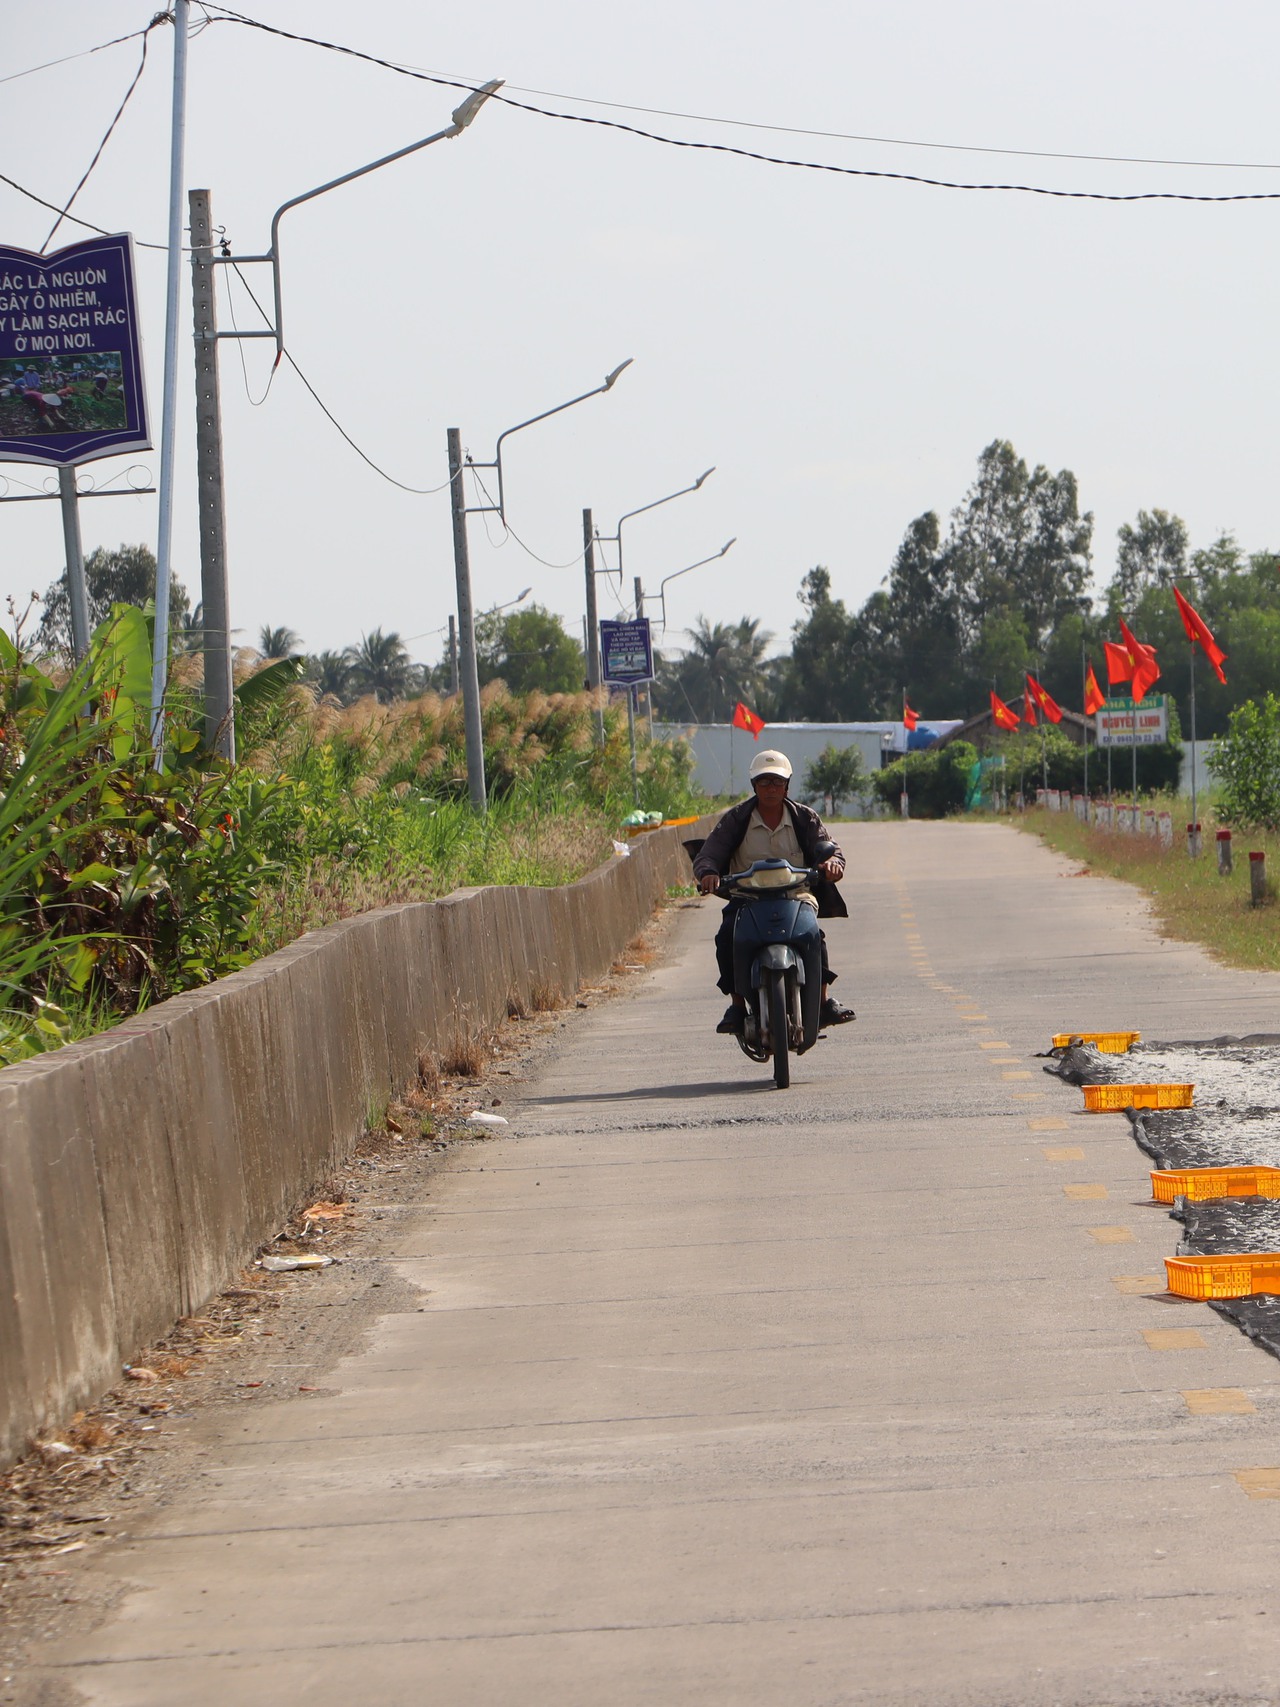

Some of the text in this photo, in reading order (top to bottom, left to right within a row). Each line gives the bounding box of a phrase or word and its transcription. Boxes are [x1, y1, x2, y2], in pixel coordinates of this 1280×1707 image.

[27, 270, 49, 289] LÀ
[51, 266, 107, 288] NGUỒN
[33, 291, 45, 310] Ô
[48, 288, 102, 309] NHIỄM,
[11, 313, 44, 331] LÀM
[48, 312, 90, 332] SẠCH
[94, 306, 126, 326] RÁC
[15, 333, 95, 353] Ở MỌI NƠI.
